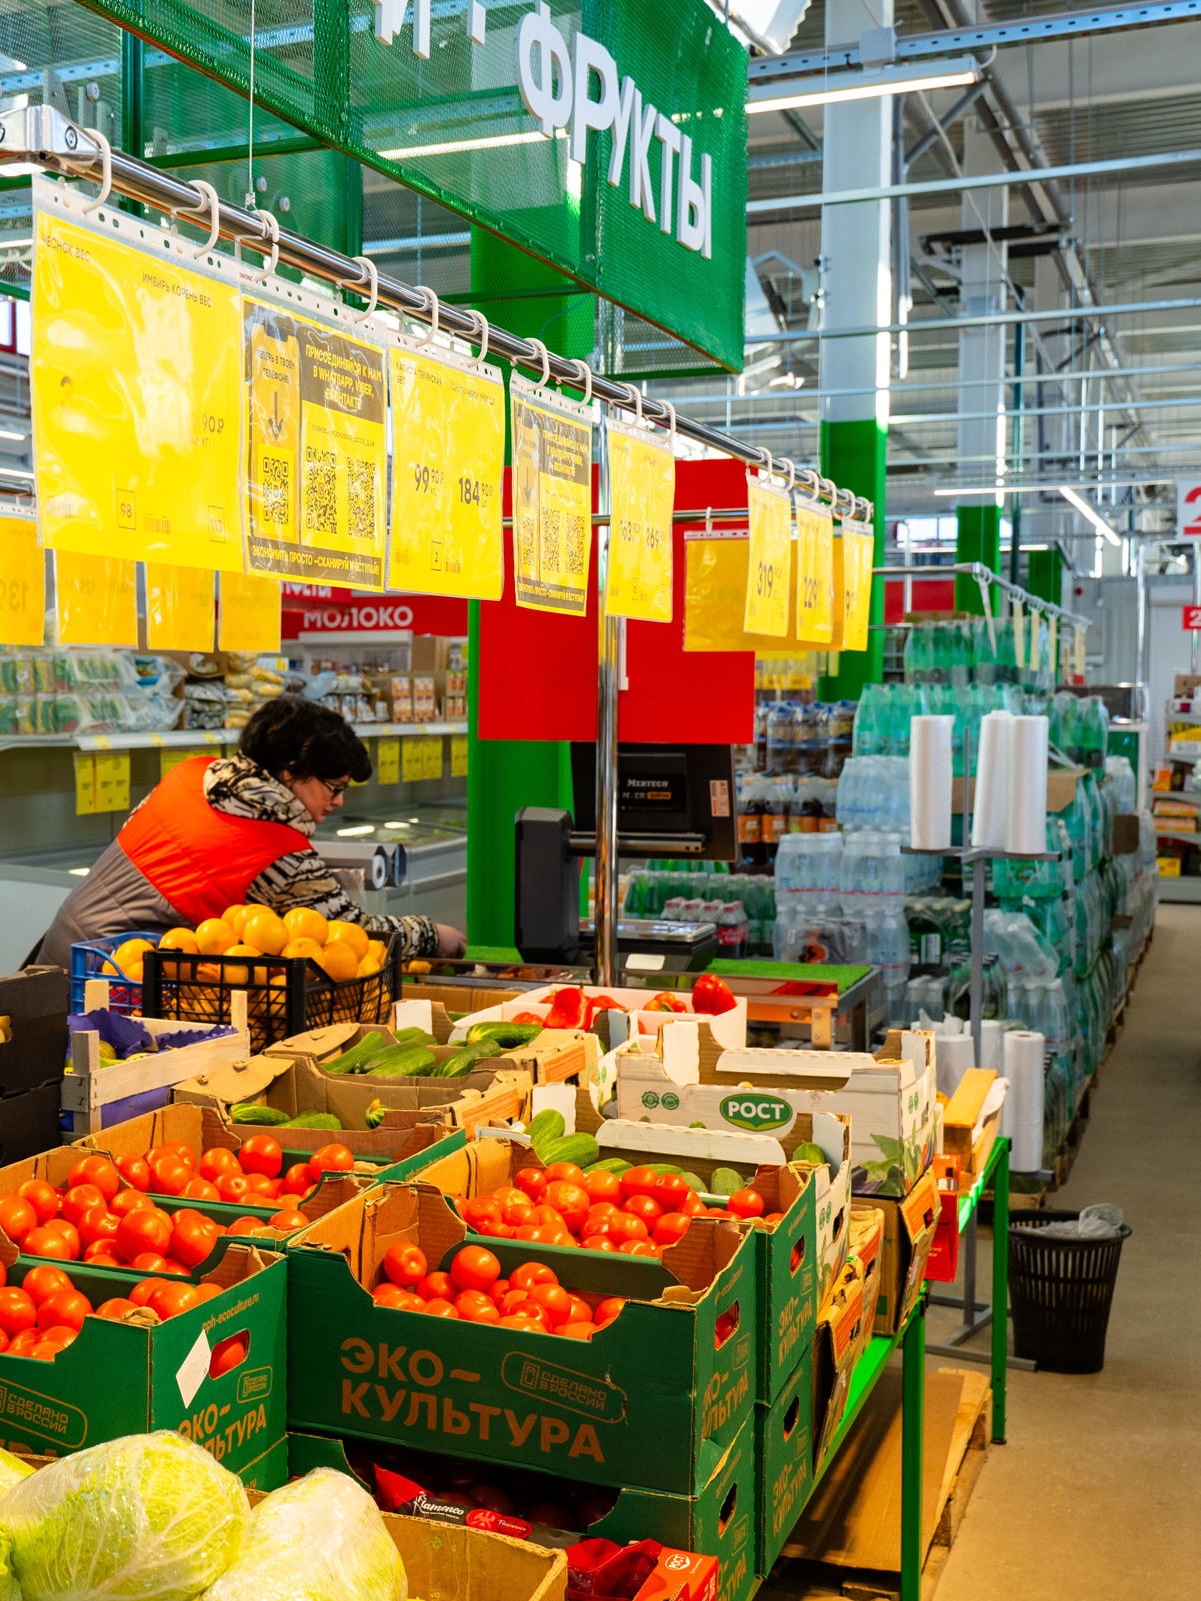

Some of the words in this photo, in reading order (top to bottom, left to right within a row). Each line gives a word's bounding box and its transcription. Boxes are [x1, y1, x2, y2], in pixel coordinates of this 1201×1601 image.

[516, 0, 713, 260] ФРУКТЫ
[75, 247, 91, 262] ВЕС
[142, 272, 171, 292] ИМБИРЬ
[171, 285, 198, 303] КОРЕНЬ
[199, 294, 212, 308] ВЕС
[305, 344, 361, 375] ПРИСОЕДИНЯЙСЯ
[415, 464, 429, 493] 99
[459, 477, 480, 507] 184
[120, 503, 133, 519] 98
[252, 545, 289, 561] ЭКОНОМИТЬ
[289, 551, 313, 566] ПРОСТО
[757, 561, 773, 598] 319
[303, 606, 413, 629] МОЛОКО
[728, 1101, 784, 1119] РОСТ
[541, 1371, 607, 1401] СДЕЛАНО
[7, 1394, 68, 1424] СДЕЛАНО
[341, 1379, 606, 1463] КУЛЬТУРА
[200, 1403, 267, 1461] ЛЬТУРА
[416, 1491, 464, 1517] Flamenco
